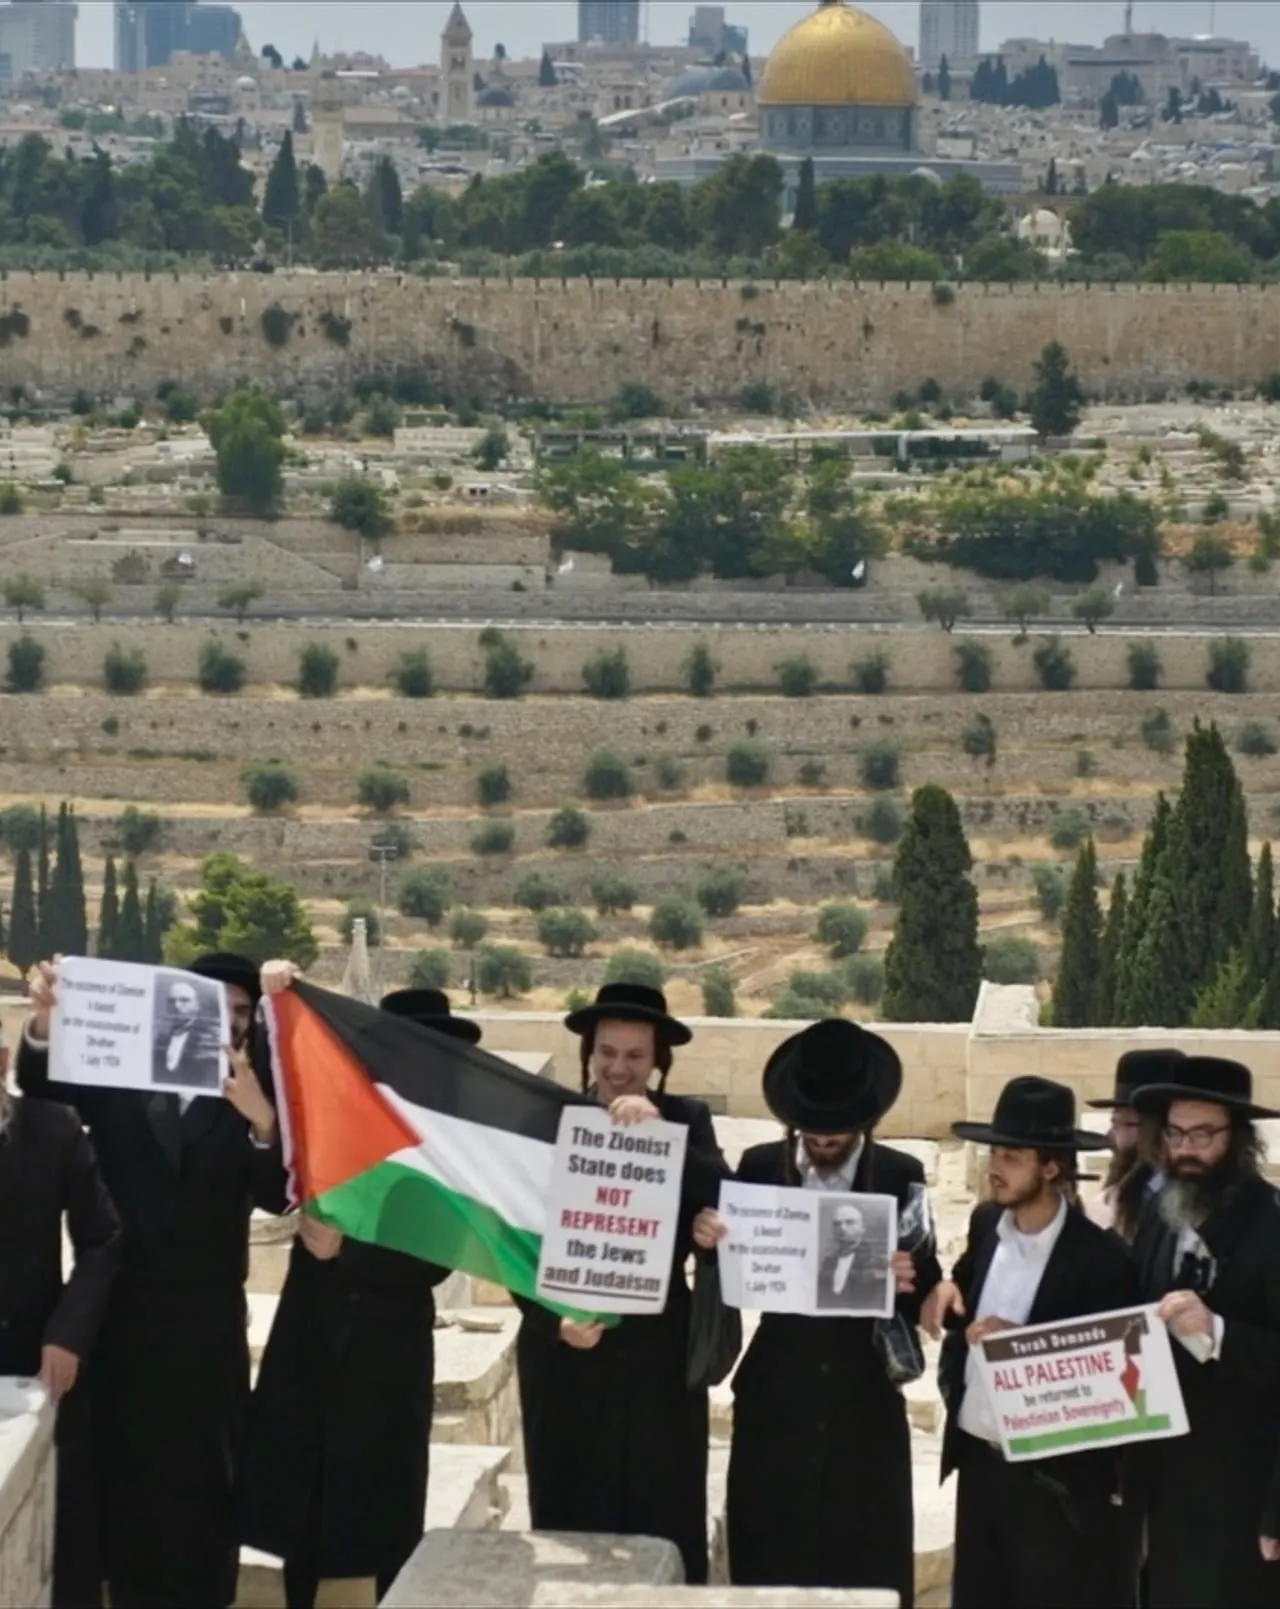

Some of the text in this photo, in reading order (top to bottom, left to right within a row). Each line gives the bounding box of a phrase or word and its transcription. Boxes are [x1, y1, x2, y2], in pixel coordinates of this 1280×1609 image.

[572, 1126, 672, 1157] The Zionist
[568, 1154, 667, 1184] State does
[596, 1185, 632, 1208] NOT
[560, 1209, 661, 1239] REPRESENT
[567, 1239, 647, 1265] the Jews
[544, 1264, 662, 1293] and Judaism
[1010, 1326, 1107, 1354] Torah Demands
[993, 1351, 1115, 1392] ALL PALESTINE
[1023, 1383, 1093, 1406] be returned to
[1002, 1398, 1127, 1432] Palestinian Sovereignty
